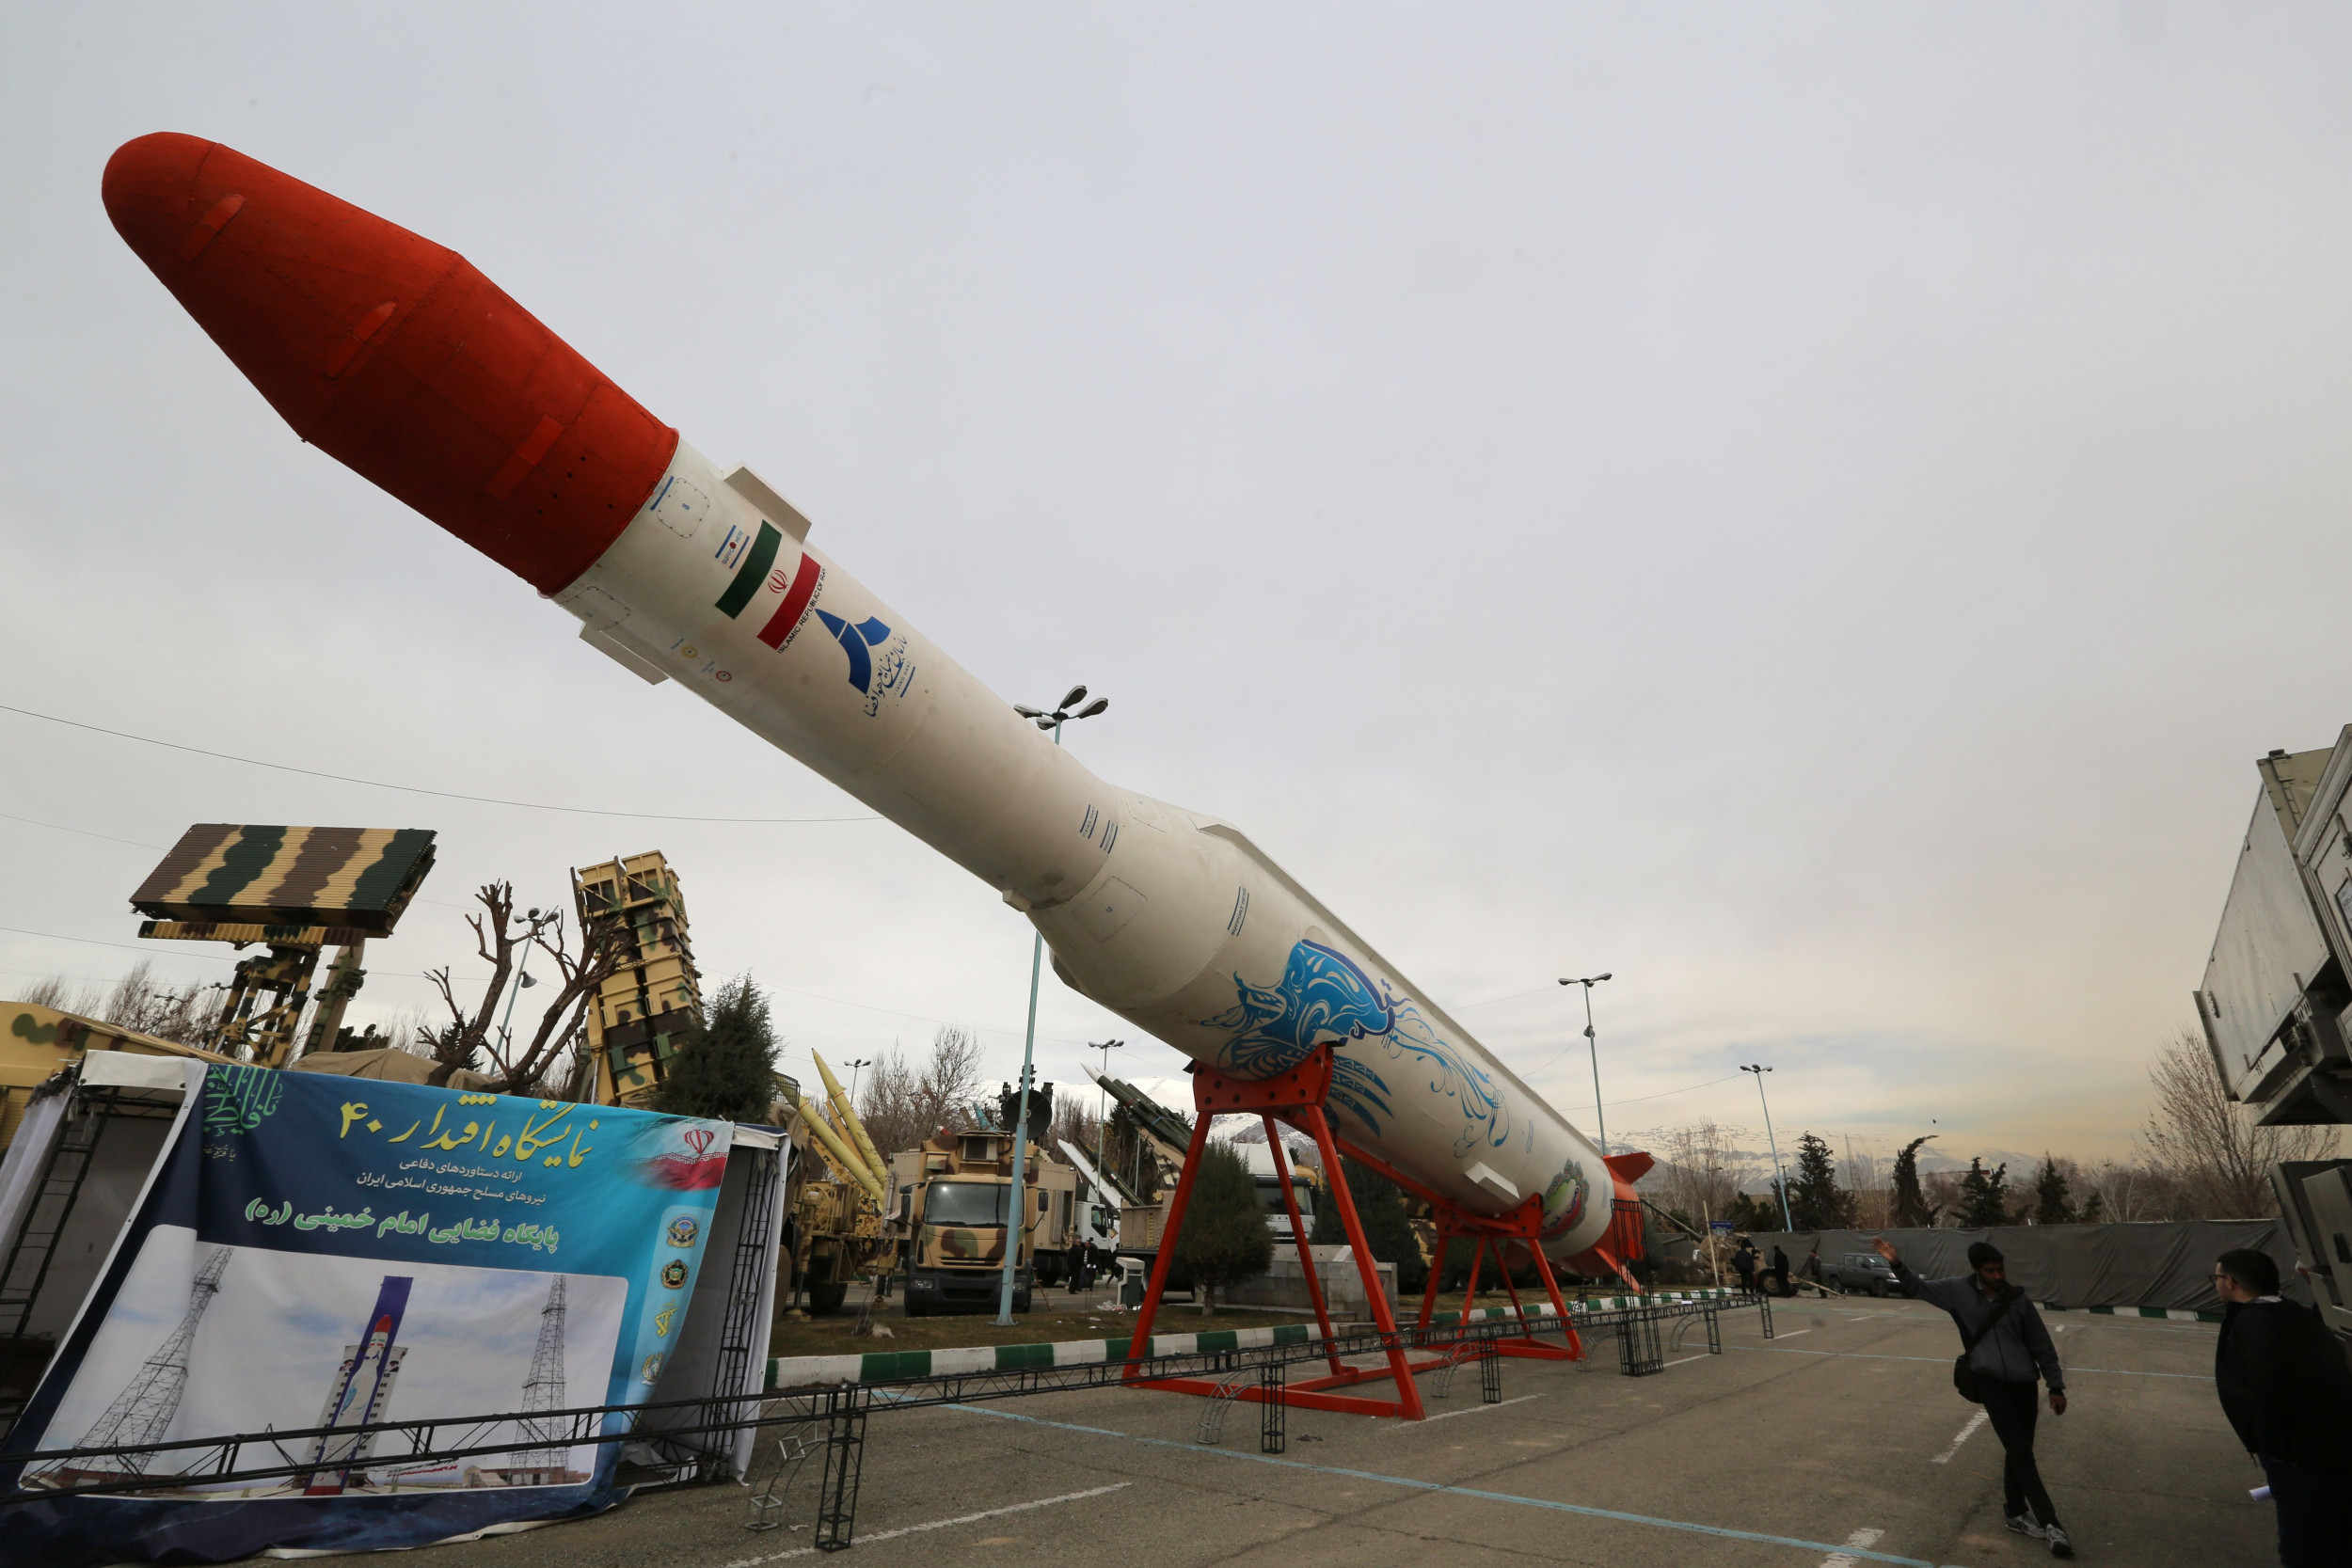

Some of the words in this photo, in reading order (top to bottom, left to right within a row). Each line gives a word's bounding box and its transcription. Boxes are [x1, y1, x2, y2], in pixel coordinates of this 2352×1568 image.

[777, 626, 801, 655] ISLAMIC
[799, 590, 820, 626] REPUBLIC
[817, 579, 823, 593] OF
[1231, 905, 1244, 936] SUPPORT
[340, 1101, 384, 1139] ۴۰
[388, 1094, 497, 1152] اقتدار
[492, 1099, 599, 1168] نمایشگاه
[399, 1158, 435, 1170] دفاعی
[436, 1162, 500, 1179] دستاوردهای
[501, 1171, 522, 1183] ارائه
[356, 1171, 386, 1185] ایران
[385, 1176, 426, 1189] اسلامی
[425, 1181, 472, 1196] جمهوری
[472, 1186, 504, 1200] مسلح
[505, 1191, 547, 1205] نیروهای
[245, 1196, 293, 1226] (ره)
[294, 1205, 377, 1233] خمینی
[376, 1211, 430, 1239] امام
[427, 1217, 501, 1244] فضایی
[502, 1222, 560, 1255] پایگاه
